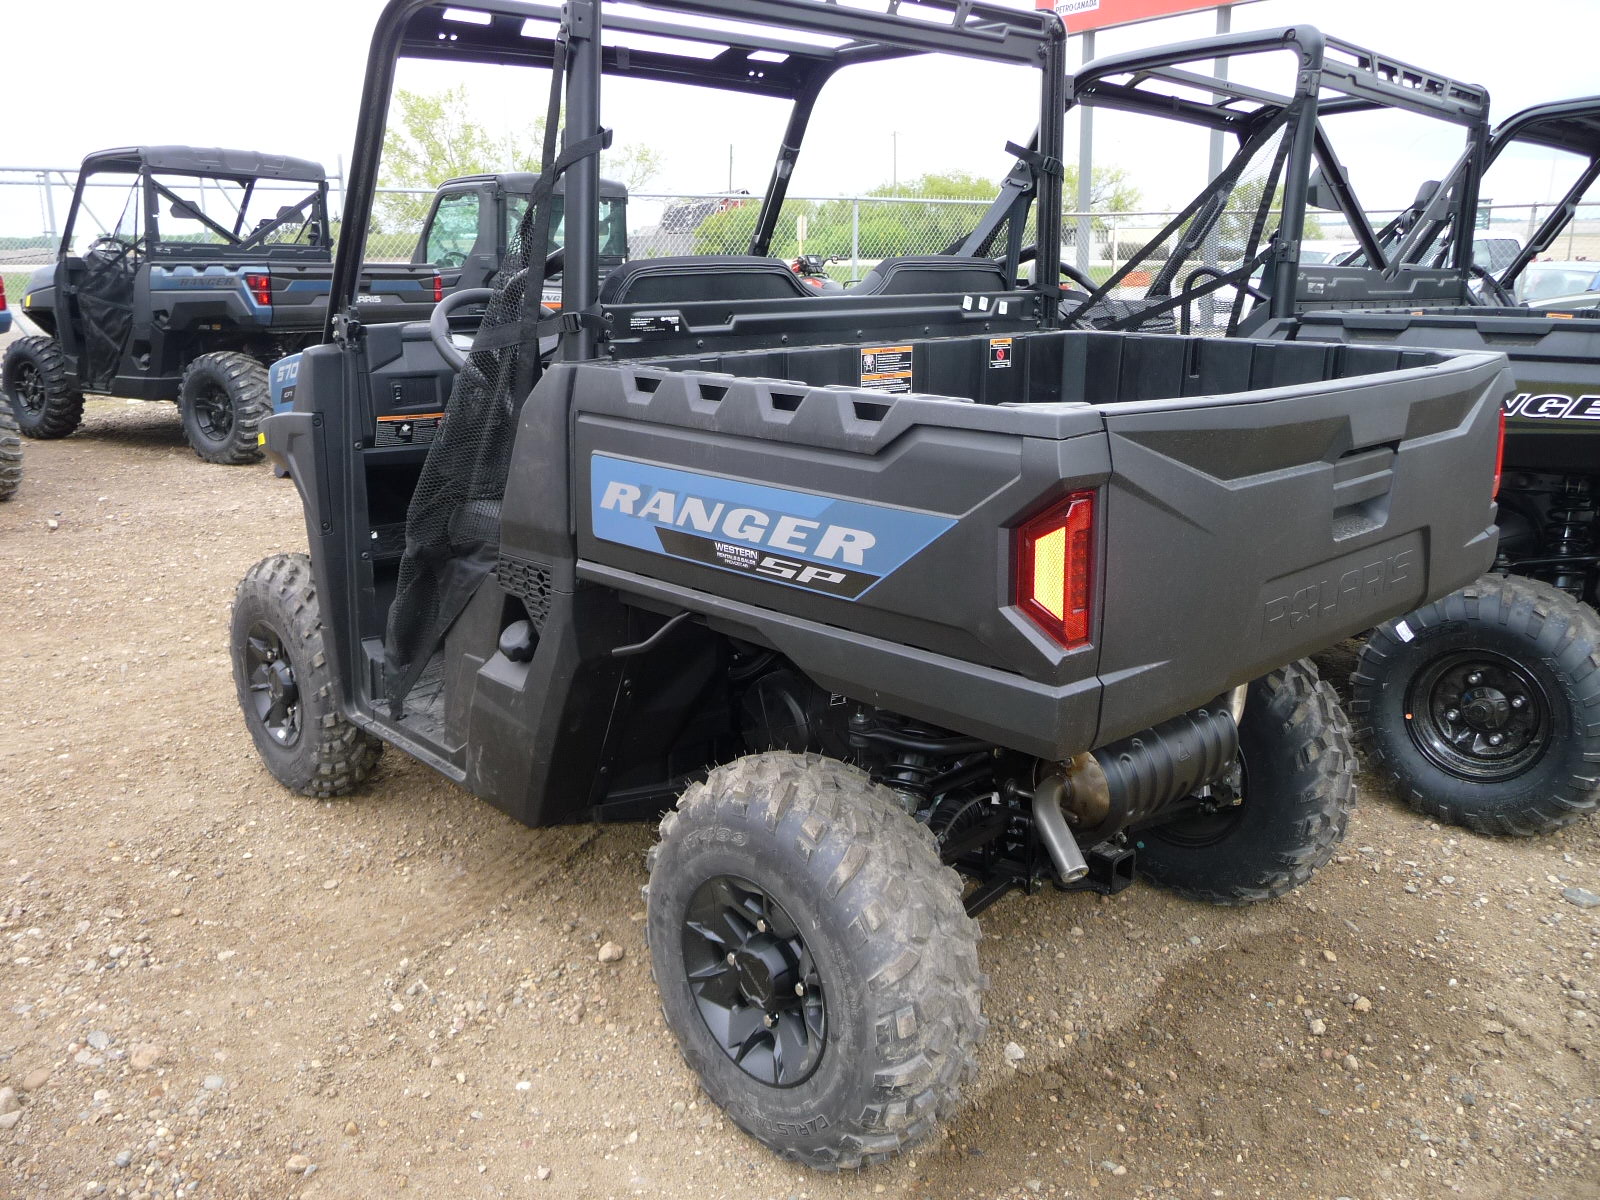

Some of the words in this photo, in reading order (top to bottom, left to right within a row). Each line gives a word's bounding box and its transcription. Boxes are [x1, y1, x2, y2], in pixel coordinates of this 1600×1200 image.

[355, 295, 382, 304] ARIS
[276, 362, 300, 383] 570
[600, 481, 876, 566] RANGER
[714, 542, 758, 559] WESTERN
[756, 556, 846, 583] SP
[1261, 550, 1413, 643] POLARIS
